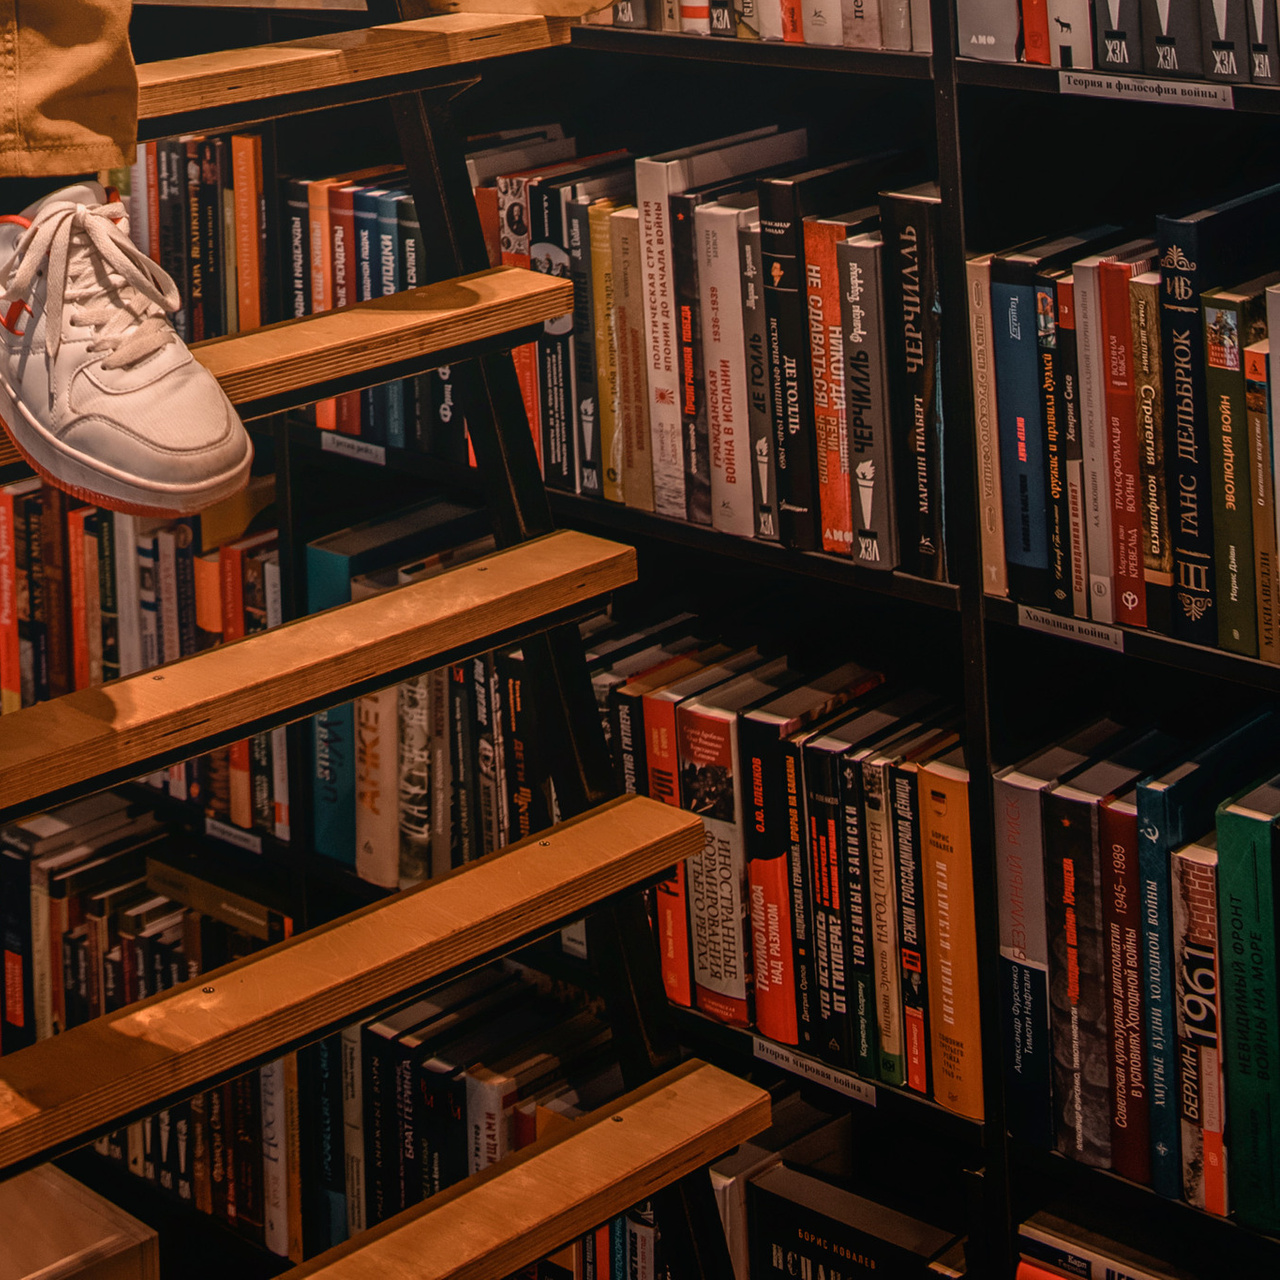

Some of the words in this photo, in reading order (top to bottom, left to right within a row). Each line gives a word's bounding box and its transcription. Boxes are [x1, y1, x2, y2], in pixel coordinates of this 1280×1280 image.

[1065, 74, 1103, 87] Теория
[1116, 80, 1177, 95] философия
[1181, 87, 1217, 98] войны
[190, 197, 200, 258] ВЕЛИКИЙ
[291, 217, 302, 277] НАДЕЖДЫ
[335, 226, 346, 284] РЕЙДЕРЫ
[643, 200, 654, 269] СТРАТЕГИЯ
[192, 264, 202, 298] КАРЛ
[900, 226, 924, 373] ЧЕРЧИЛЛЬ
[647, 273, 661, 370] ПОЛИТИЧЕСКАЯ
[708, 370, 722, 468] ГРАЖДАНСКАЯ
[849, 350, 873, 453] ЧЕРЧИЛЛЬ
[1172, 329, 1198, 463] ДЕЛЬБРЮК
[1220, 395, 1232, 432] ВОЙН
[1222, 434, 1237, 511] ЭВОЛЮЦИЯ
[1179, 474, 1200, 537] ГАНС
[1026, 608, 1074, 631] Холодная
[1078, 624, 1109, 639] война
[845, 805, 860, 875] ЗАПИСКИ
[718, 839, 736, 980] ИНОСТРАННЫЕ
[766, 904, 781, 956] РАЗУМОМ
[849, 882, 865, 965] ТЮРЕМНЫЕ
[1145, 880, 1158, 926] ВОЙНЫ
[1230, 894, 1245, 956] ФРОНТ
[771, 959, 782, 984] НАД
[1109, 923, 1123, 998] дипломатия
[1146, 932, 1162, 1001] ХОЛОДНОЙ
[1250, 931, 1263, 979] МОРЕ
[1010, 966, 1021, 1015] Фурсенко
[1182, 943, 1217, 1039] 1961
[1231, 961, 1250, 1075] НЕВИДИМЫЙ
[1252, 986, 1265, 1012] НА
[1012, 1018, 1023, 1073] Александр
[1113, 1001, 1127, 1066] культурная
[1149, 1007, 1165, 1049] БУДНИ
[1255, 1016, 1269, 1080] ВОЙНЫ
[401, 1060, 412, 1121] ГЕРИНГА
[758, 1041, 789, 1062] Вторая
[793, 1057, 831, 1079] мировая
[834, 1074, 861, 1091] война
[1152, 1056, 1166, 1107] ХМУРЫЕ
[1182, 1044, 1199, 1119] БЕРЛИН
[1115, 1068, 1128, 1128] Советская
[403, 1123, 414, 1159] БРАТ
[797, 1228, 828, 1250] БОРИС
[833, 1243, 876, 1268] КОВАЛЕВ
